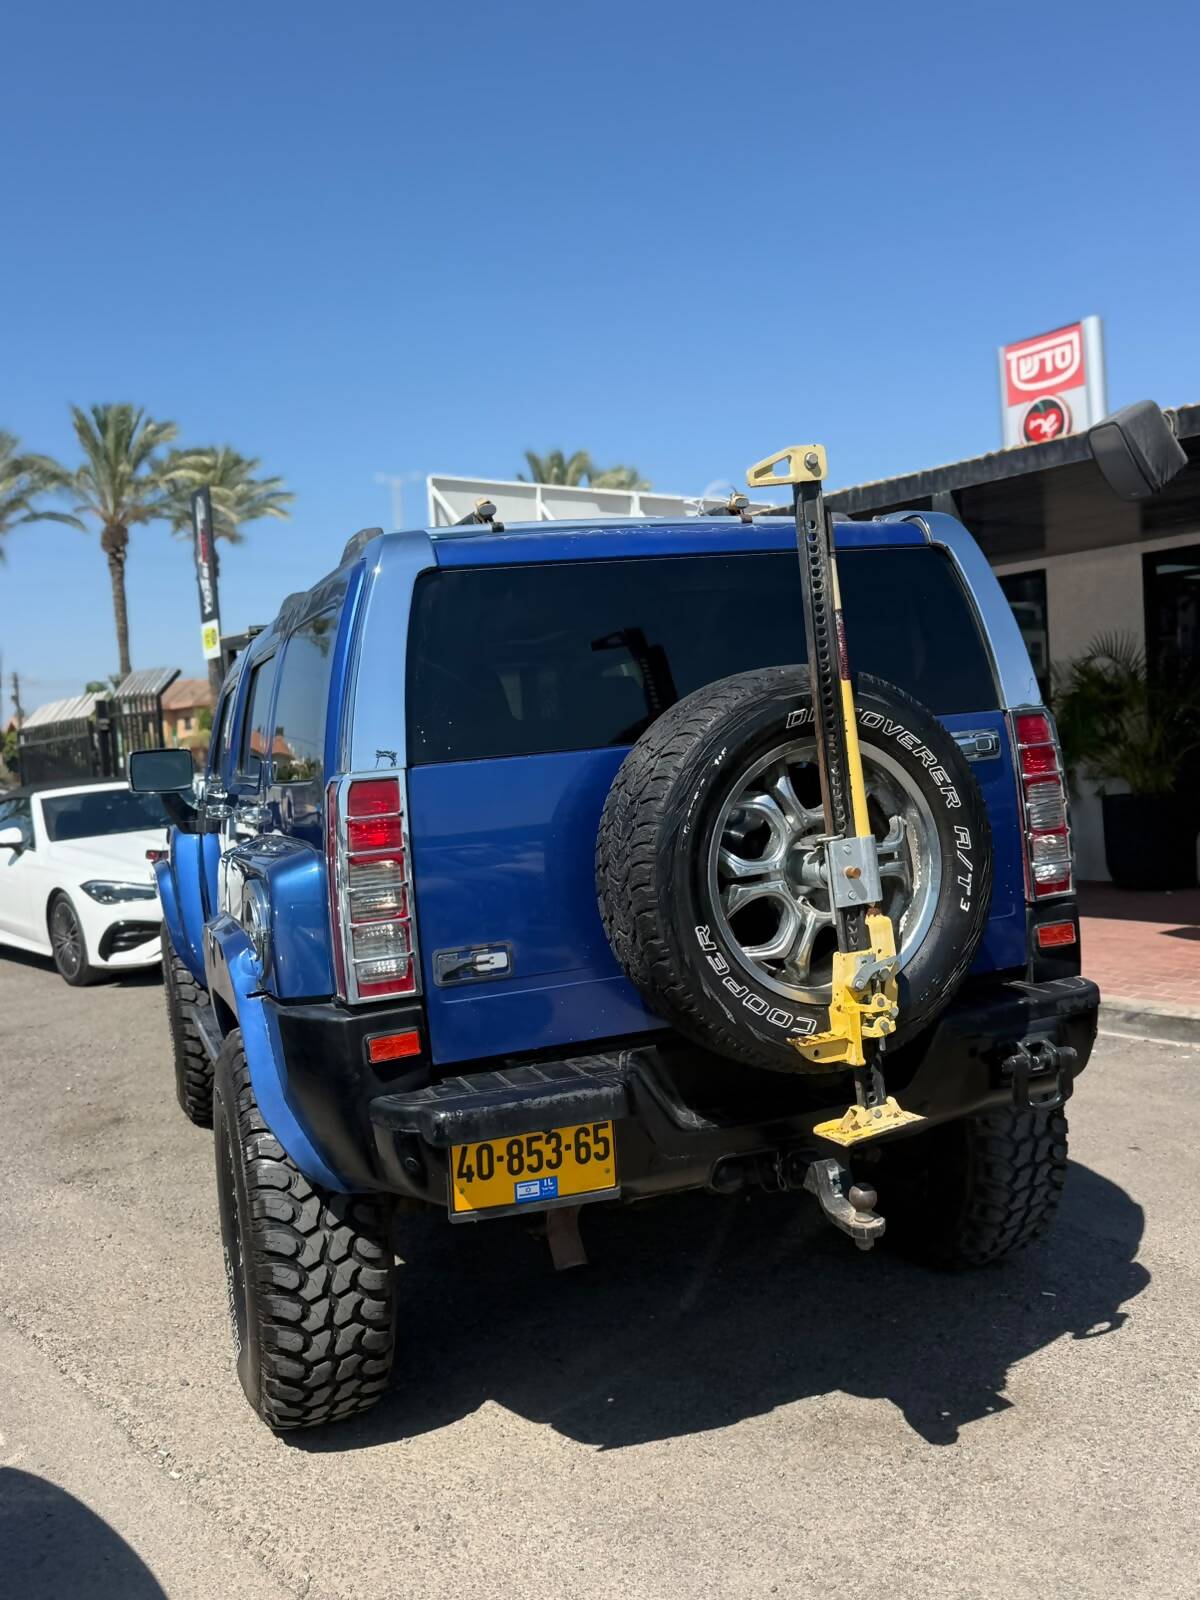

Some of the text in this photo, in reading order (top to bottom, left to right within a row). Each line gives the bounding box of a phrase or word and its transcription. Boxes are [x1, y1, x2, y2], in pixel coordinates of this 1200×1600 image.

[786, 707, 961, 809] DIOVERER
[695, 925, 817, 1035] COOPER
[457, 1122, 610, 1183] 40-853-65
[543, 1178, 554, 1187] IL
